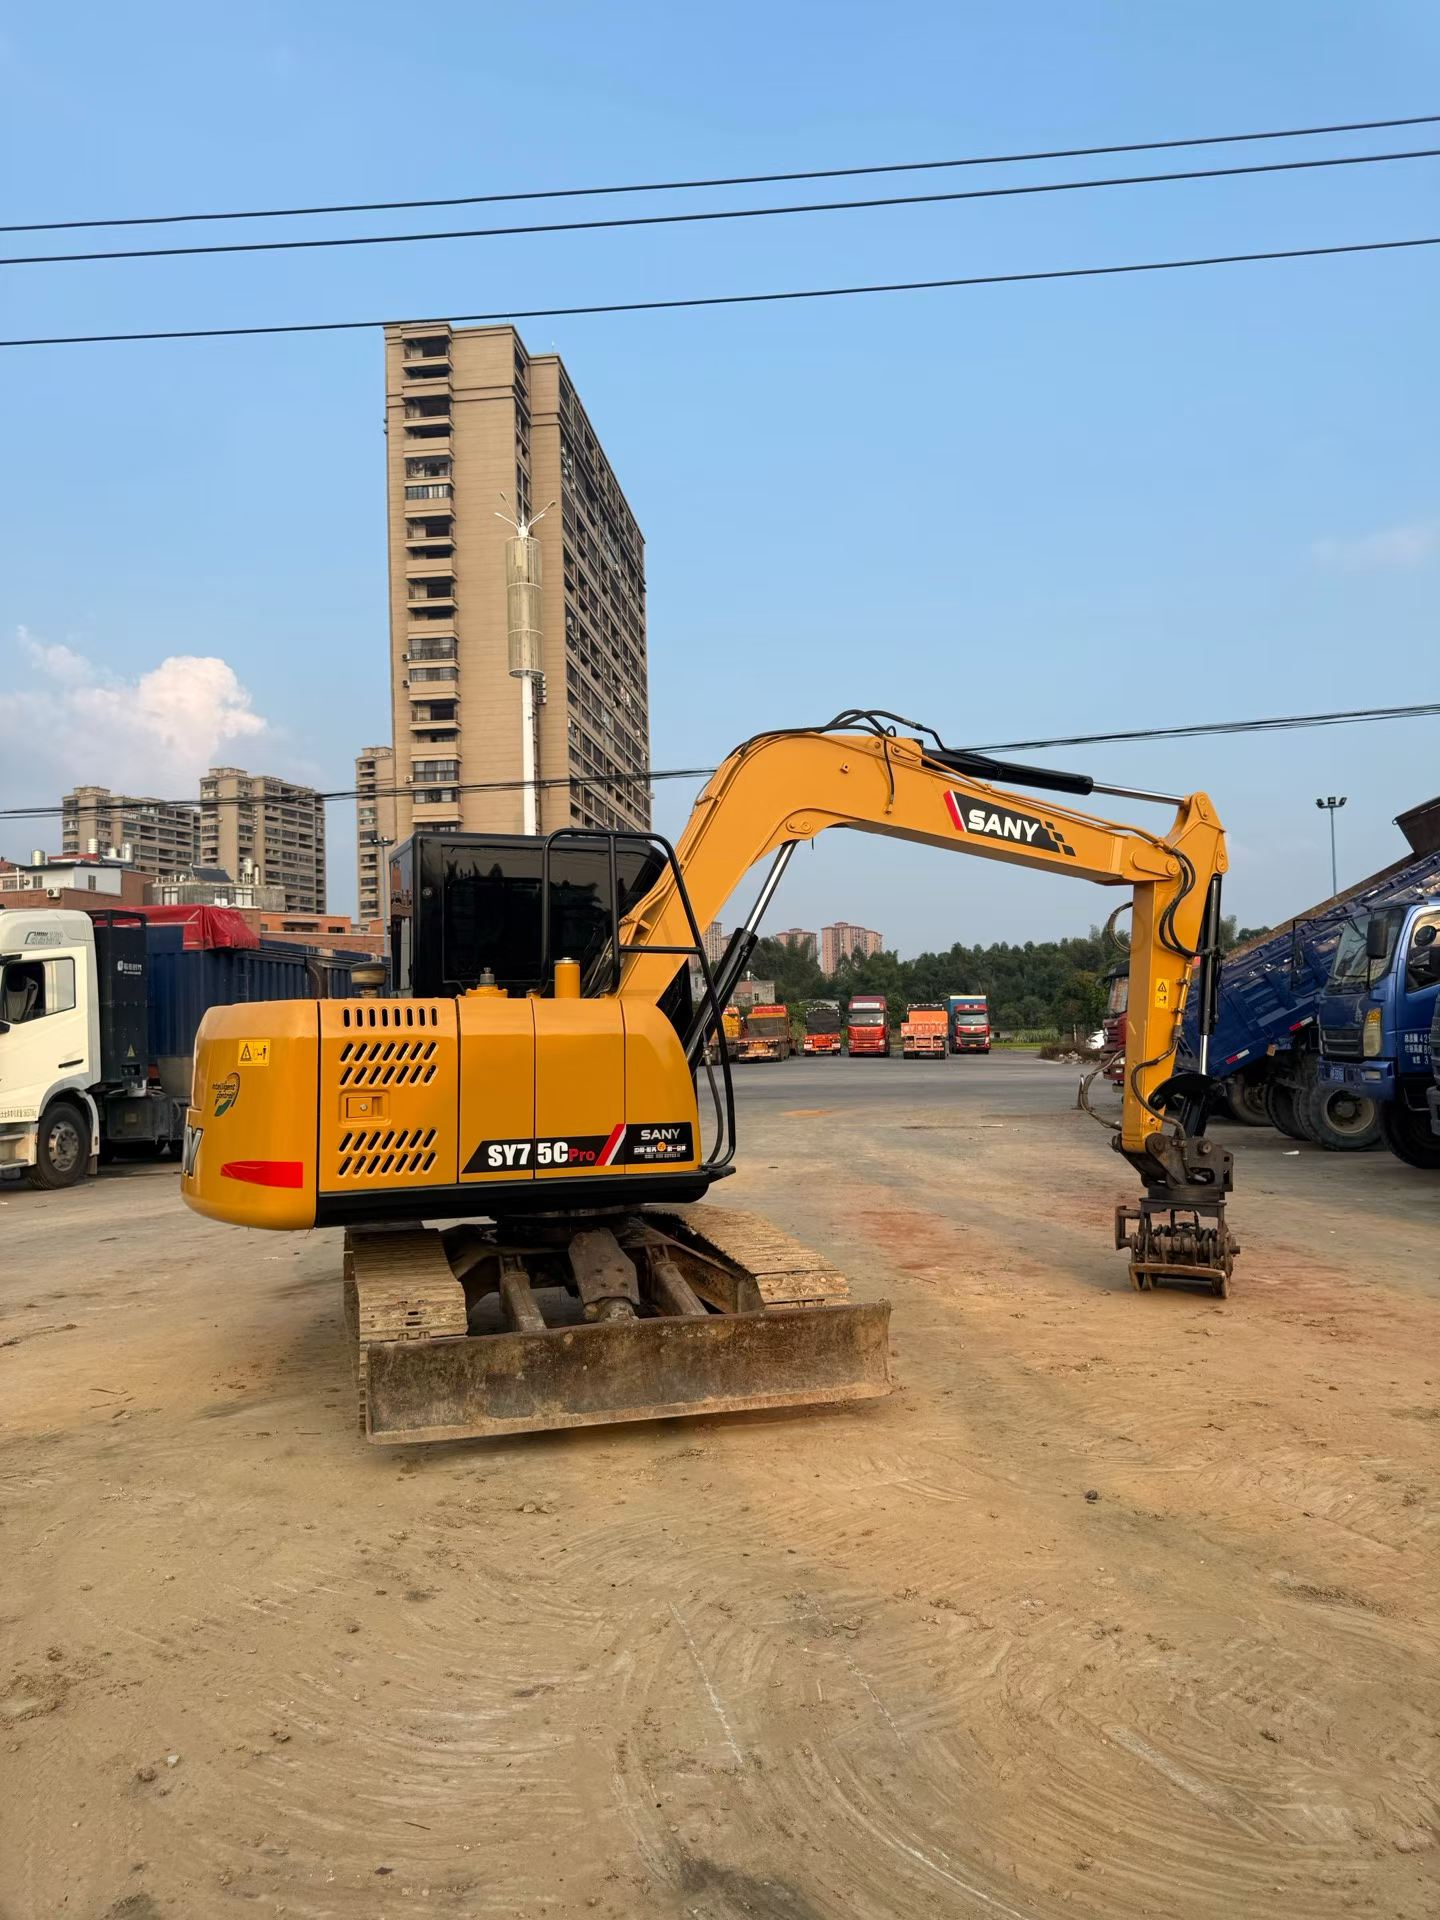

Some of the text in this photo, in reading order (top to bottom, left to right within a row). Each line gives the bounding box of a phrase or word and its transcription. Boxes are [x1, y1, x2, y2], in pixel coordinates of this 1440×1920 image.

[968, 809, 1039, 842] SANY
[641, 1128, 680, 1140] SANY
[568, 1148, 596, 1162] Pro
